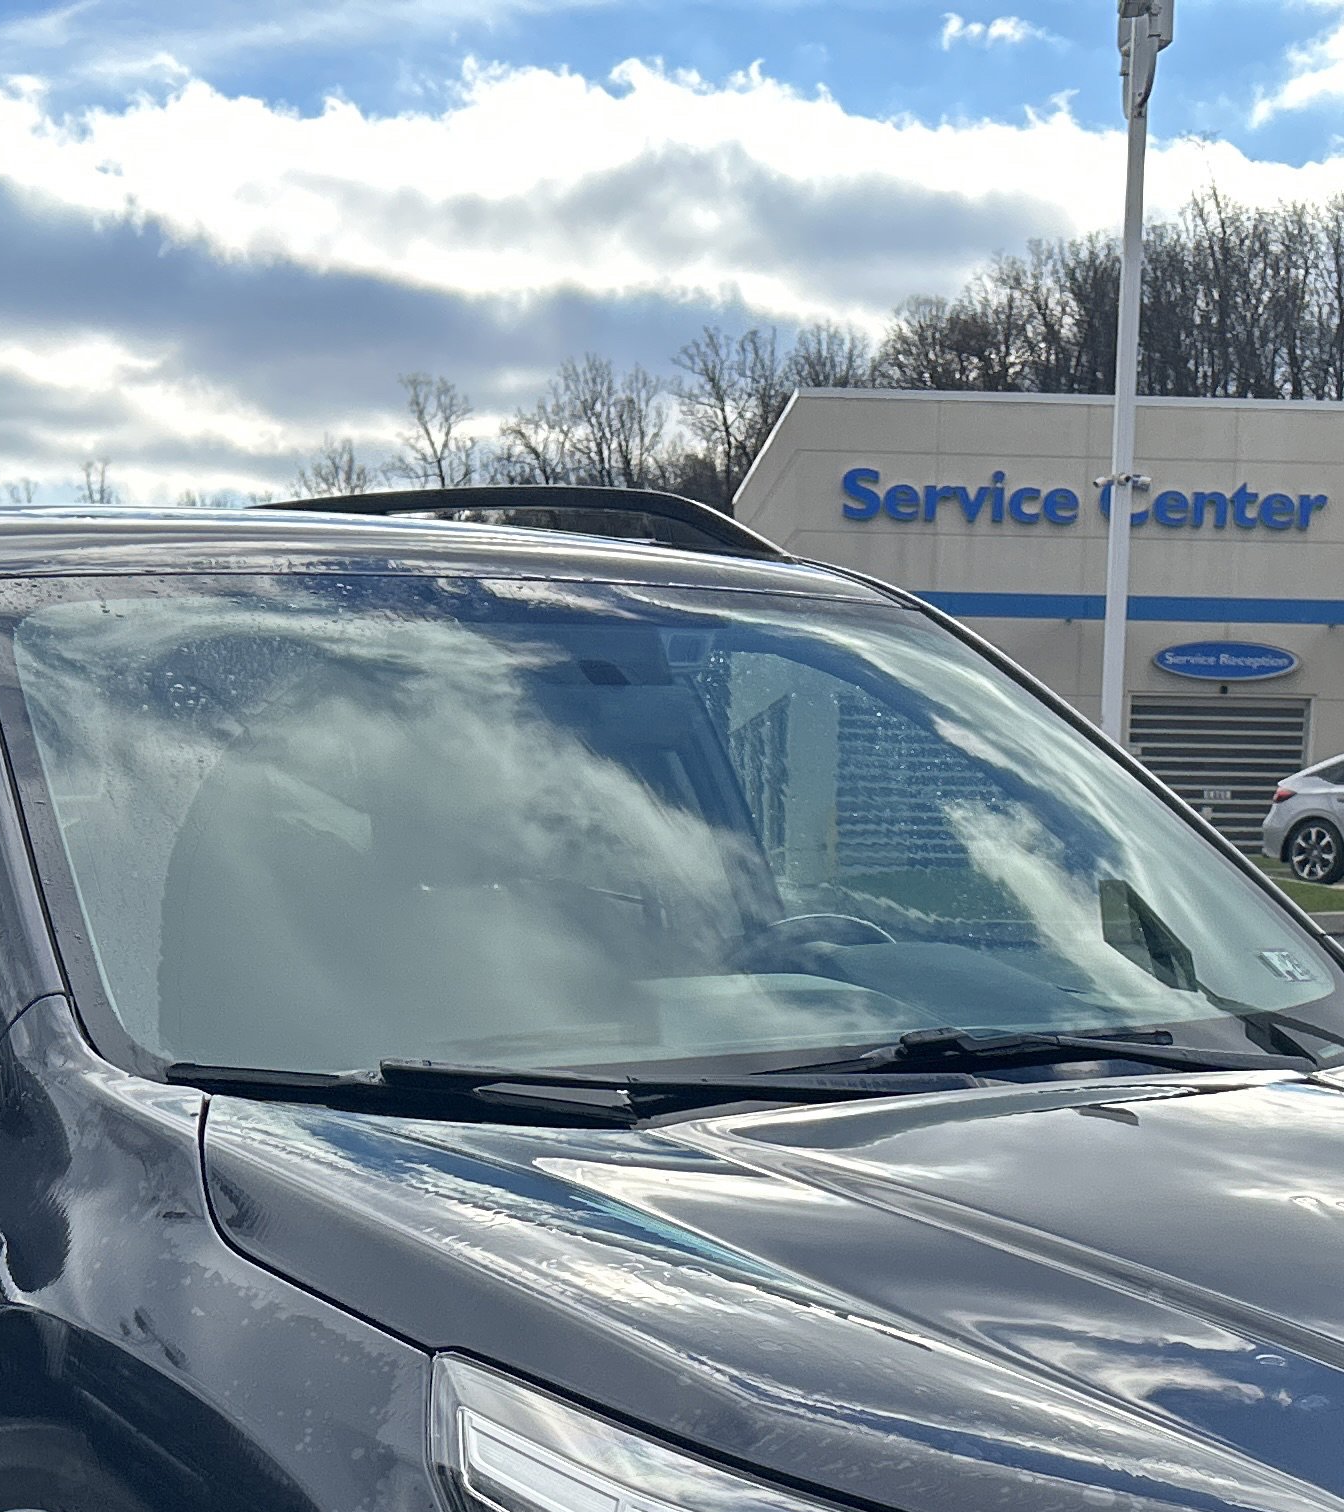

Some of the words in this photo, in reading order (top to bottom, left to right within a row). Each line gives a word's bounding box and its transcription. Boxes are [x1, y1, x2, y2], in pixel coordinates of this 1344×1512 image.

[842, 467, 1080, 524] Service
[1164, 651, 1216, 666] Service
[1219, 652, 1289, 670] Reception
